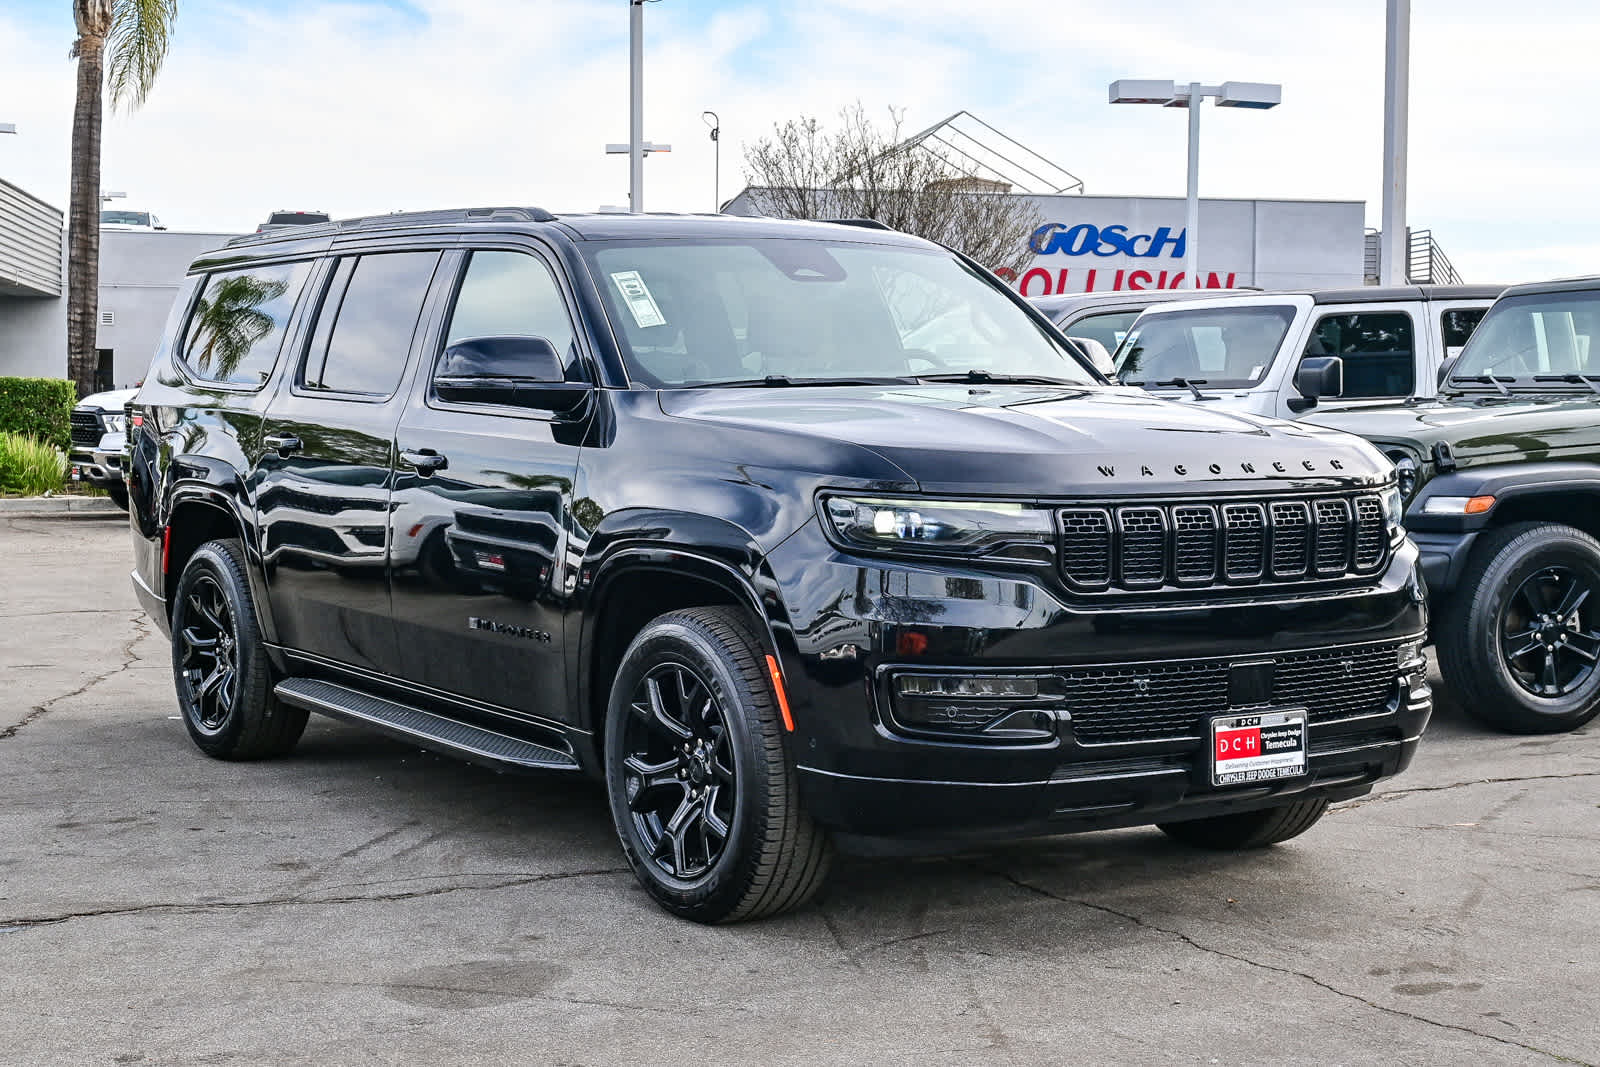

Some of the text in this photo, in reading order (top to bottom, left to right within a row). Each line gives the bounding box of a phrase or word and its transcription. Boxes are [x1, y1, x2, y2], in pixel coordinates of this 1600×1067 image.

[1097, 458, 1345, 478] WAGONEER
[1265, 738, 1297, 750] Temecula
[1220, 766, 1304, 783] CHRYSLER JEEP DODGE TEMECULA
